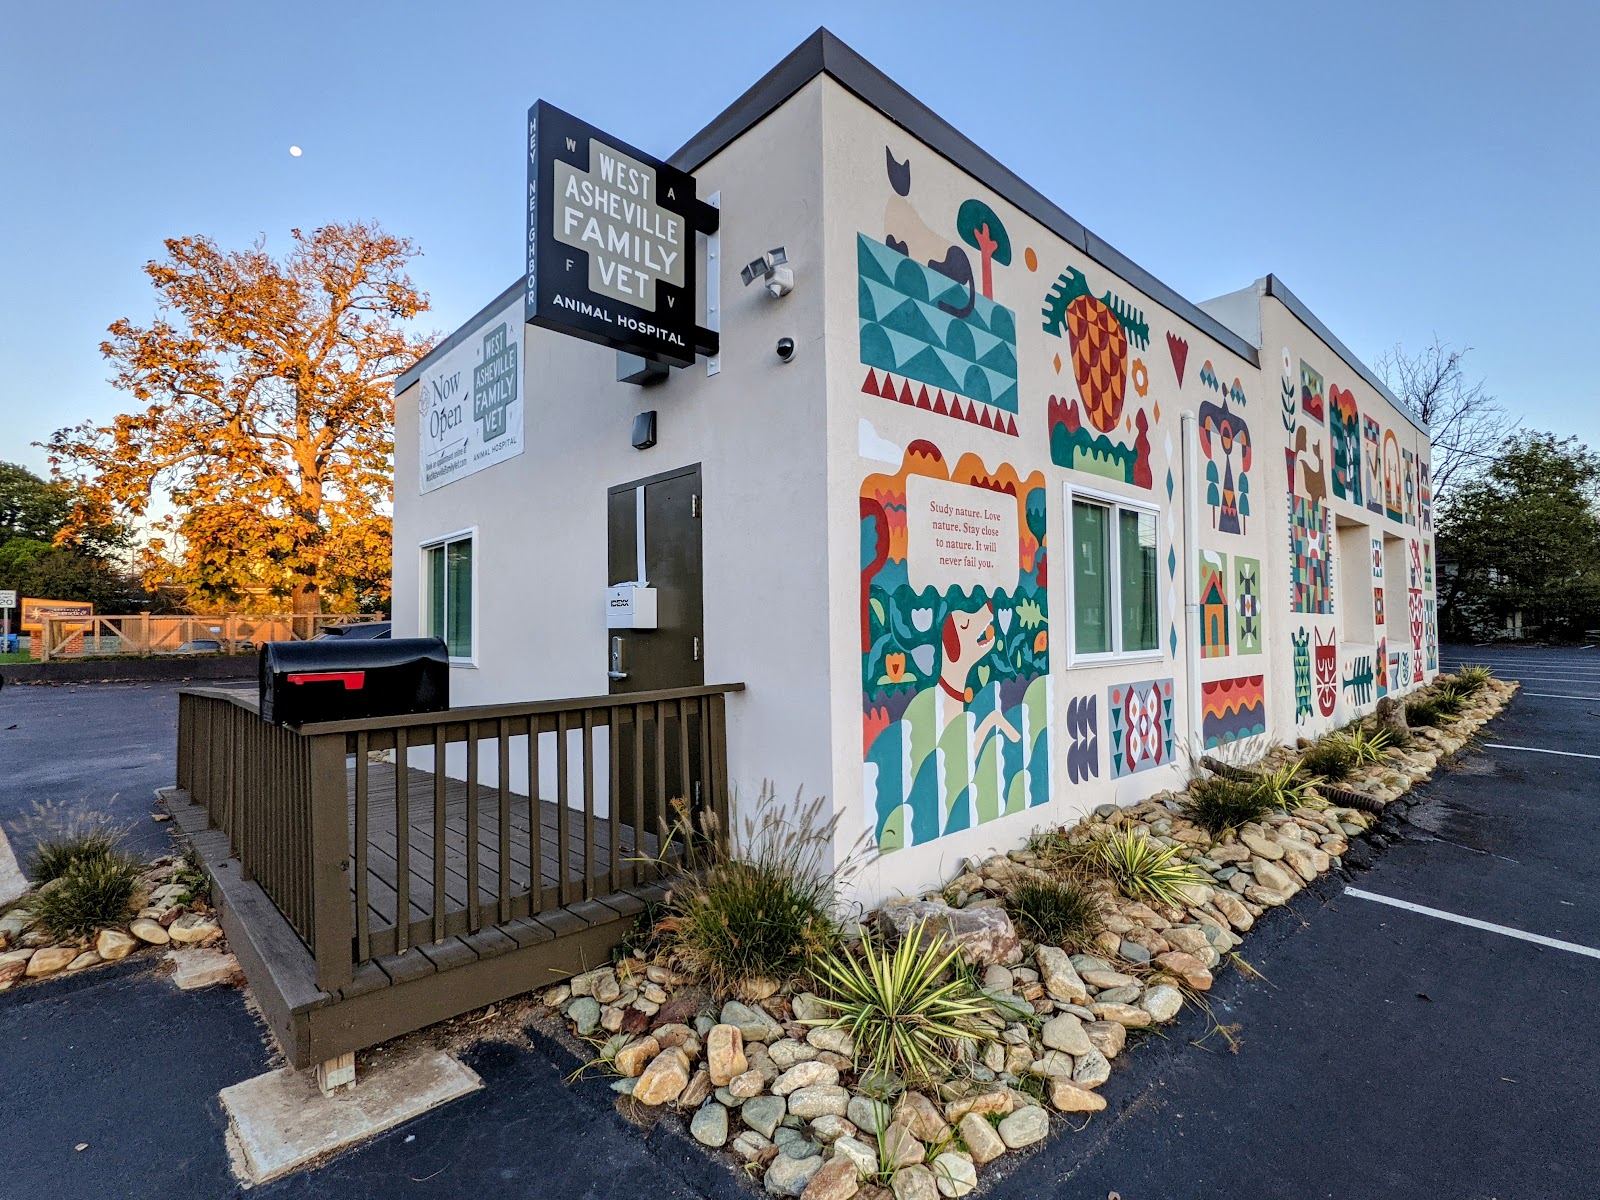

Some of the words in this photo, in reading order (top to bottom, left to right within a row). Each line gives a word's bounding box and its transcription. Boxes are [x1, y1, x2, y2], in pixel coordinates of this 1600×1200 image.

[529, 117, 537, 164] HEY
[565, 136, 577, 153] W
[599, 152, 650, 200] WEST
[565, 174, 678, 245] ASHEVILLE
[667, 187, 676, 201] A
[528, 180, 536, 305] NEIGHBOR
[564, 206, 678, 275] FAMILY
[565, 258, 575, 272] F
[597, 256, 650, 299] VET
[667, 295, 676, 309] V
[552, 294, 613, 323] ANIMAL
[617, 315, 686, 347] HOSPITAL
[485, 330, 504, 358] WEST
[475, 349, 515, 390] ASHEVILLE
[431, 371, 461, 407] Now
[475, 374, 514, 414] FAMILY
[429, 403, 463, 442] Open
[485, 404, 504, 432] VET
[473, 450, 491, 461] ANIMAL
[491, 436, 517, 454] HOSPITAL
[930, 500, 954, 517] Study
[955, 507, 982, 519] nature.
[984, 509, 1001, 521] Love
[932, 521, 961, 533] nature.
[963, 522, 980, 535] Stay
[981, 525, 999, 537] close
[936, 537, 944, 547] to
[945, 540, 974, 551] nature.
[976, 540, 982, 551] It
[983, 542, 997, 552] will
[939, 556, 962, 566] never
[963, 556, 976, 568] fail
[978, 559, 994, 570] you.
